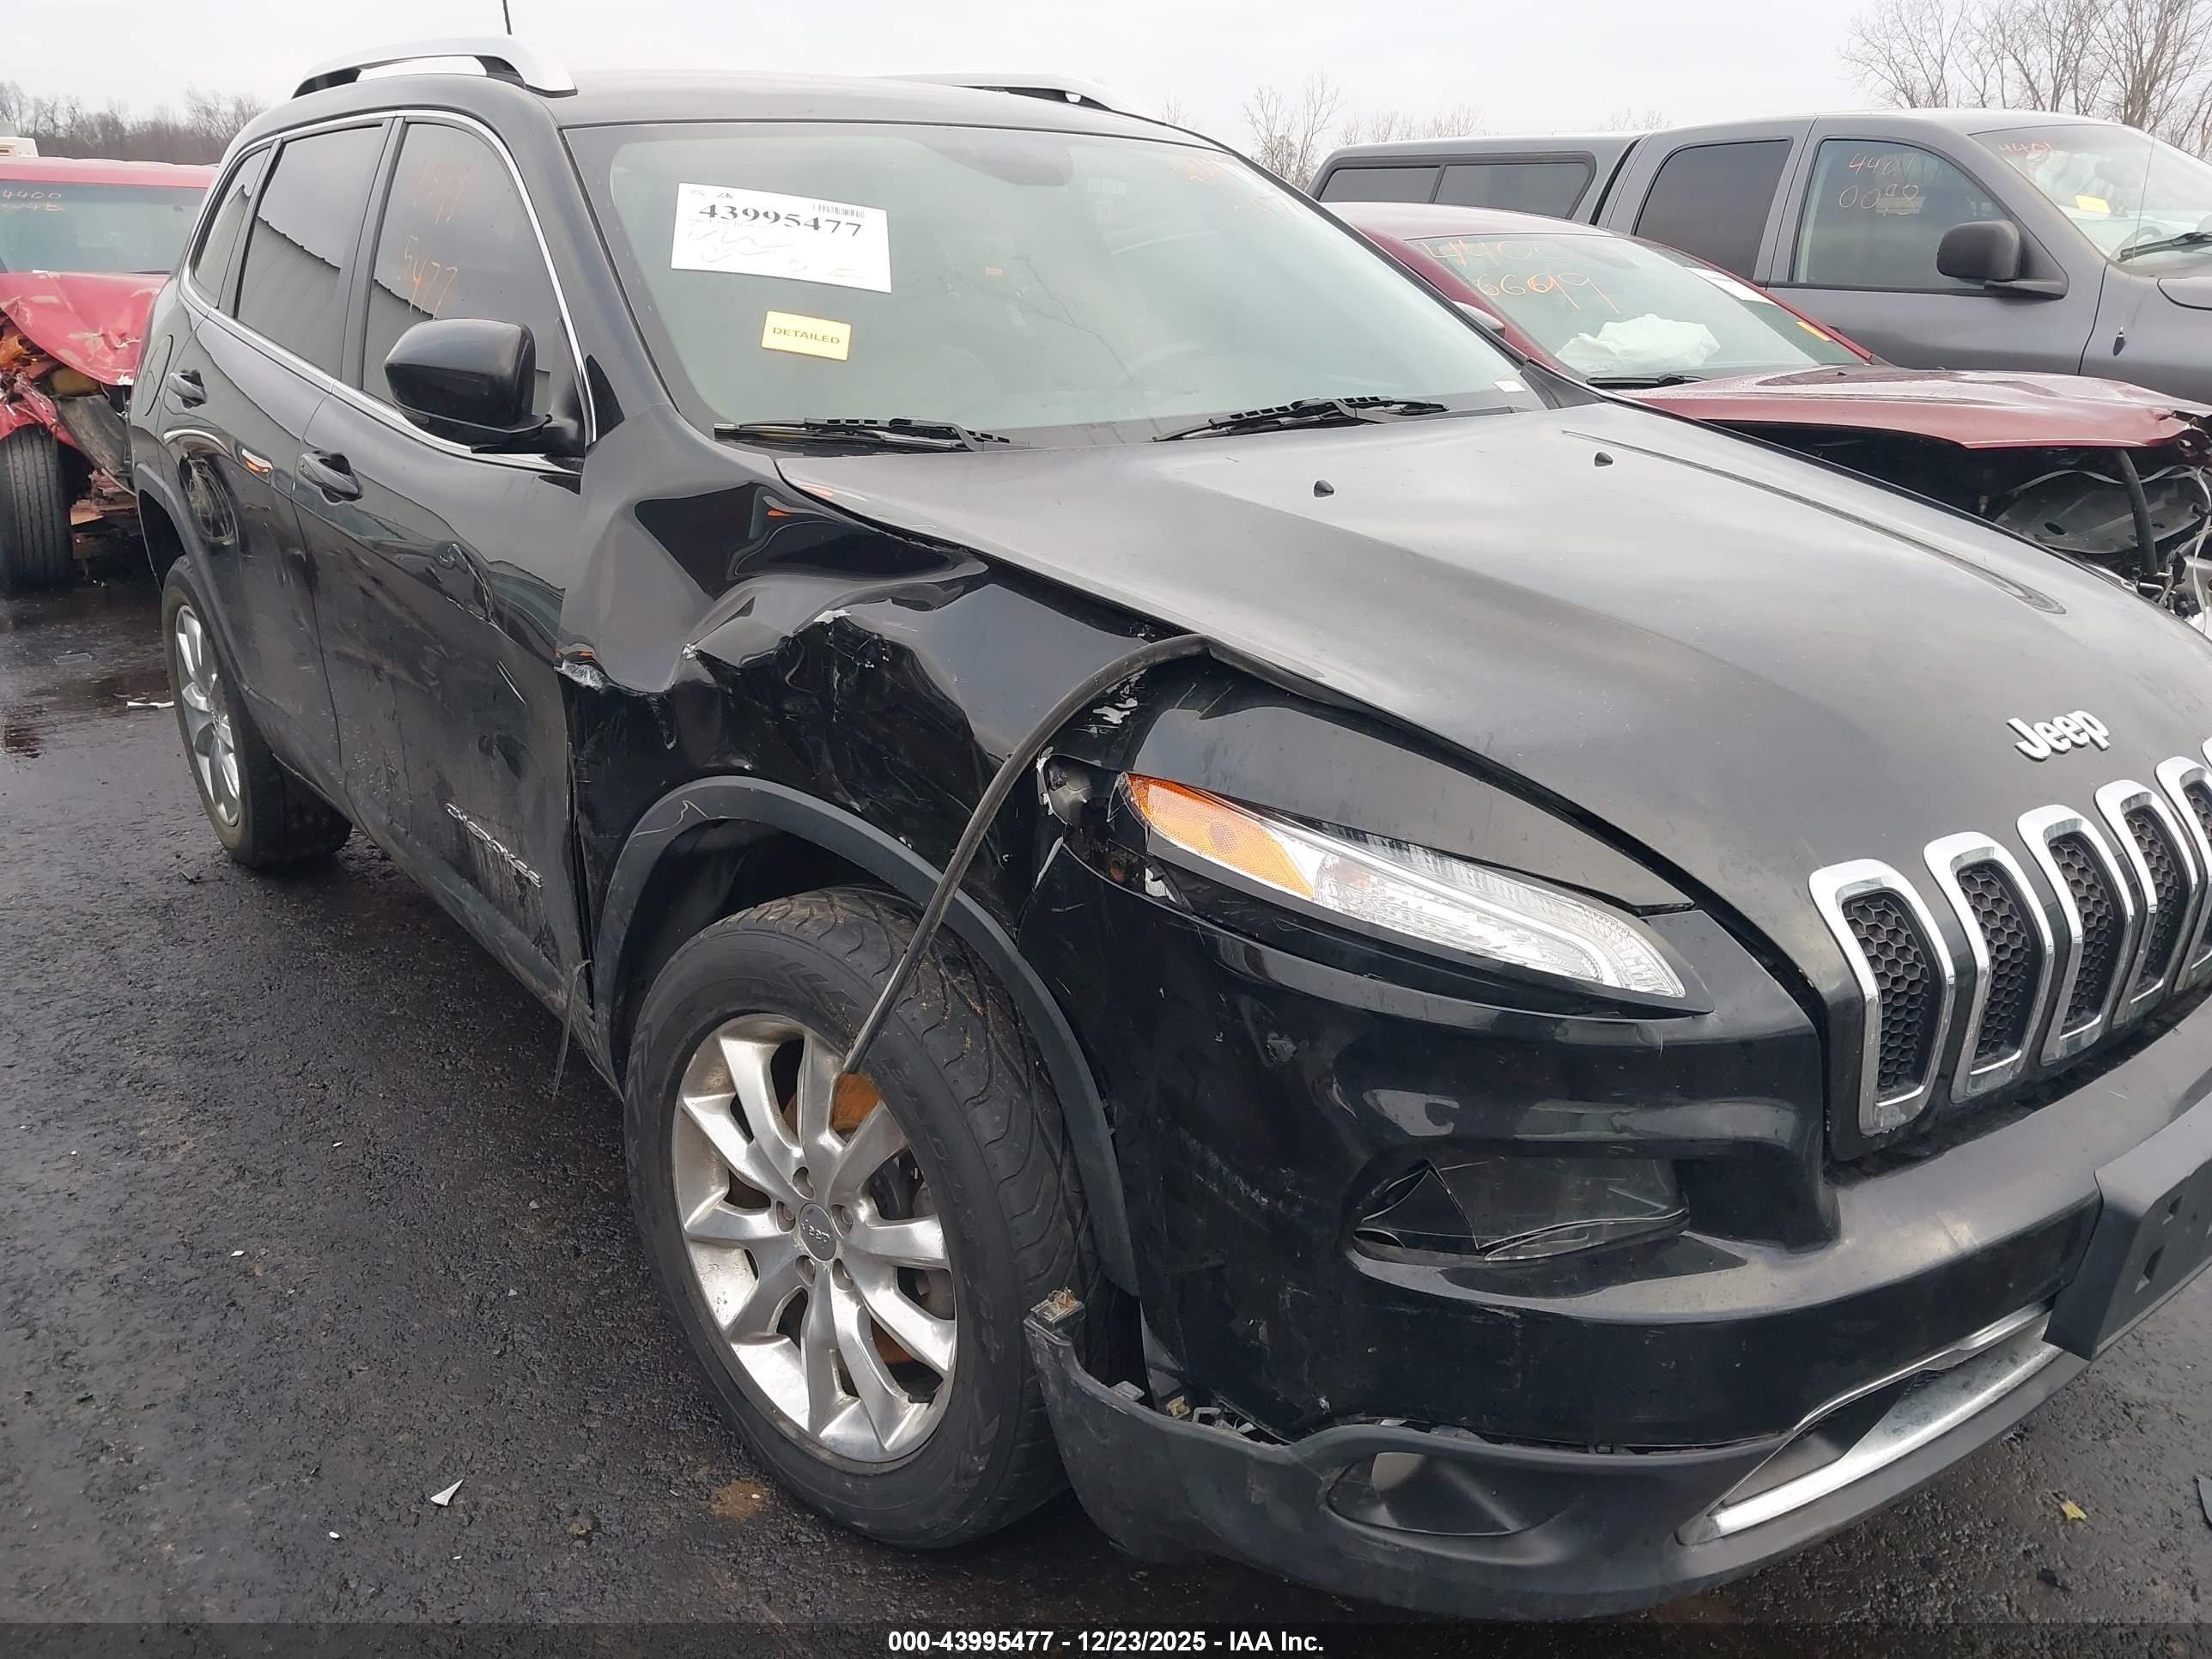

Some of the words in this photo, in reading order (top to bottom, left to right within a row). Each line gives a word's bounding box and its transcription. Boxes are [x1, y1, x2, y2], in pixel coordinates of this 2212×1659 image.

[698, 203, 863, 238] 43995477
[772, 325, 842, 345] DETAILED
[2006, 710, 2111, 763] Jeep
